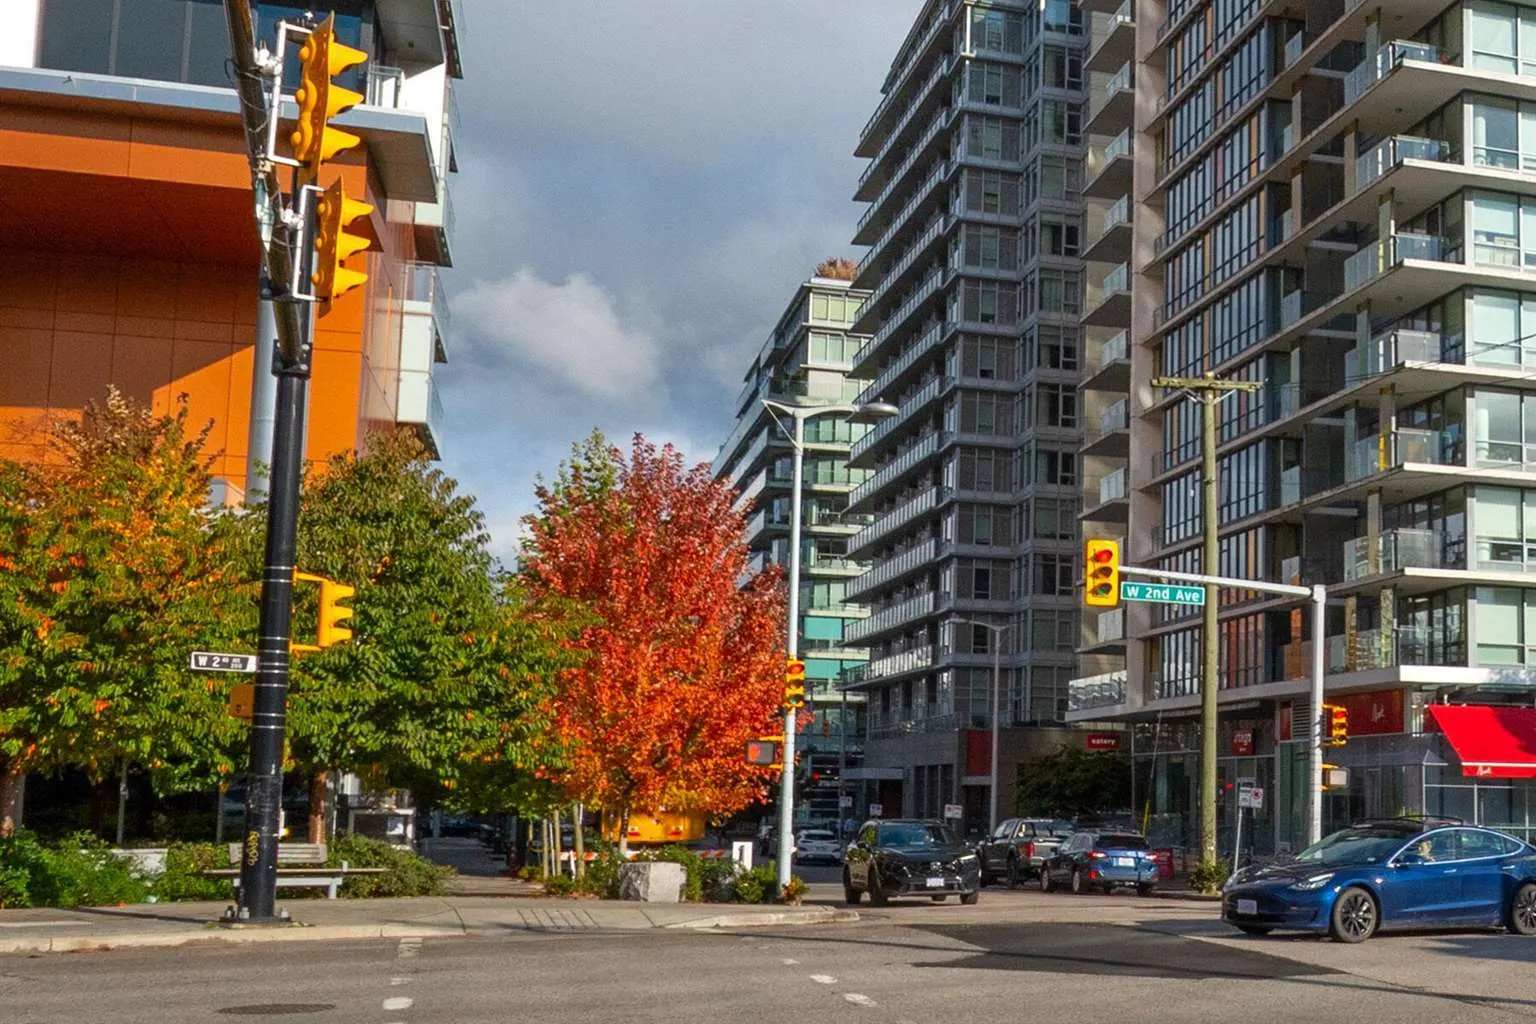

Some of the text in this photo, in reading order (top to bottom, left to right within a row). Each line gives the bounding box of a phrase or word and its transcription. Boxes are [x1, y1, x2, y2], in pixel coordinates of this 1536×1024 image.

[1126, 585, 1200, 602] W 2nd Ave
[198, 655, 208, 667] W
